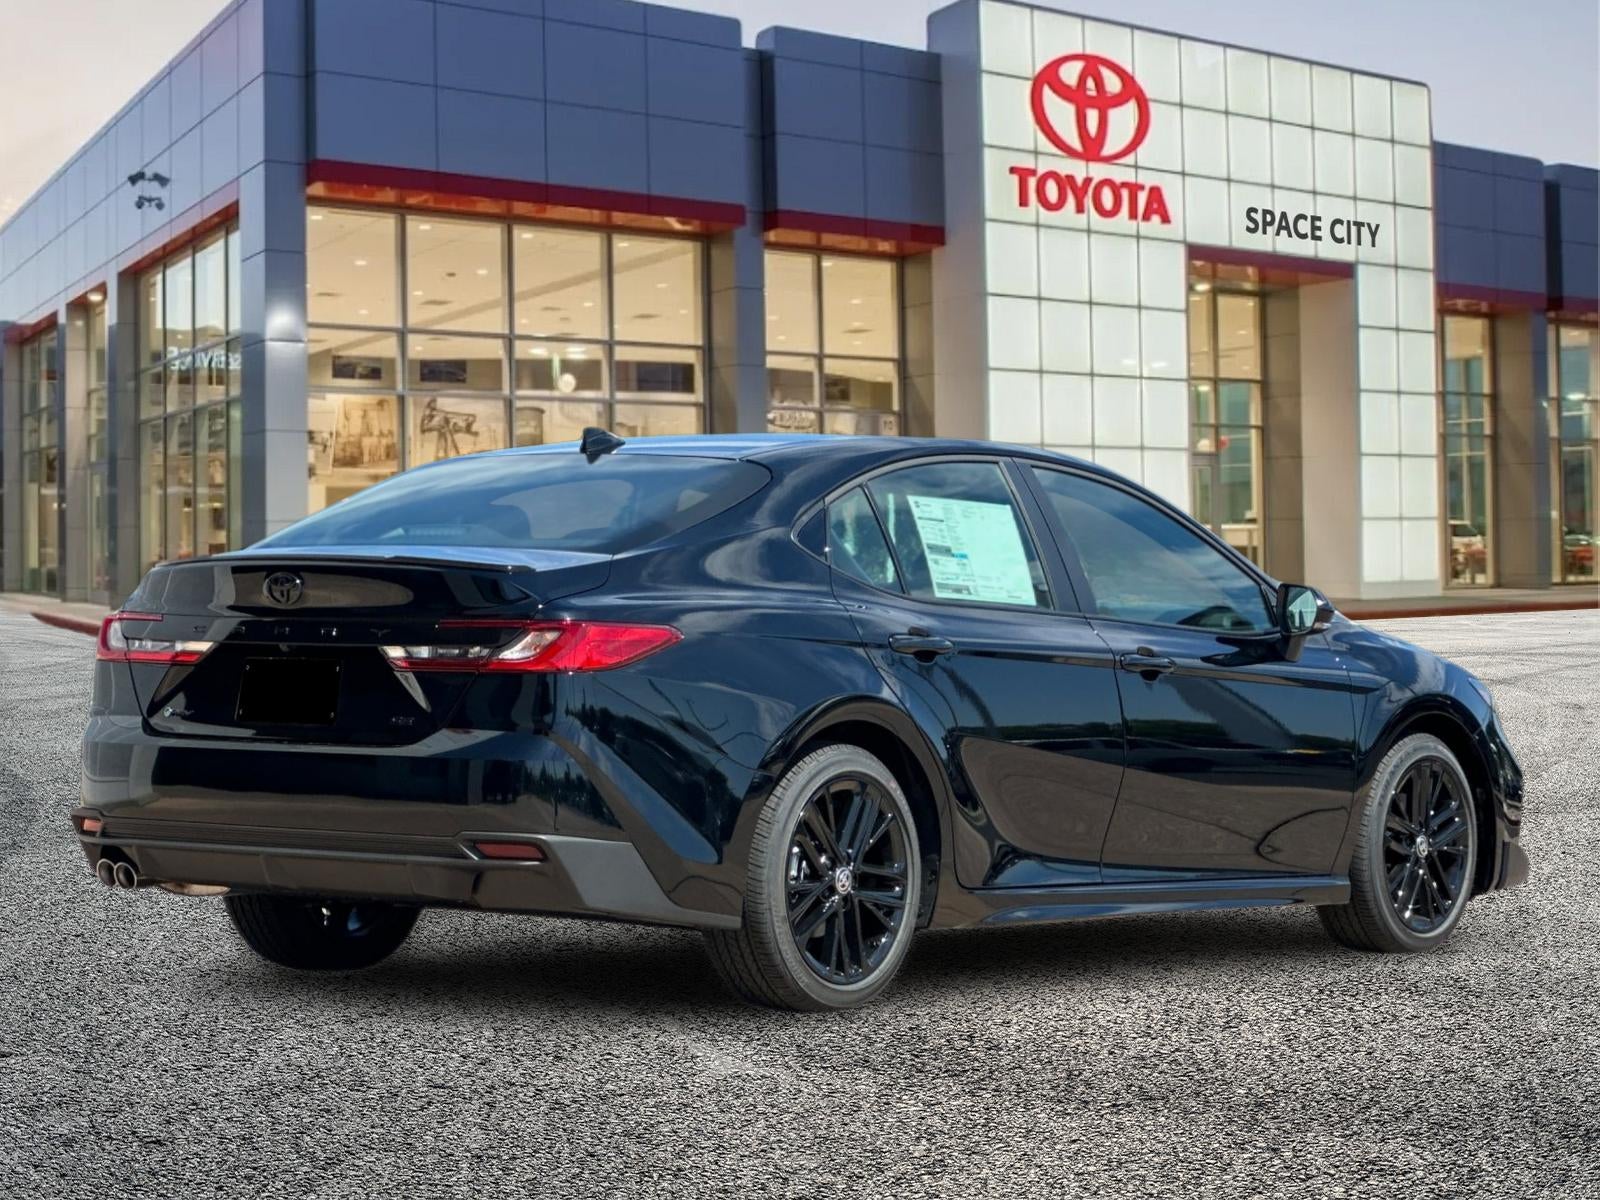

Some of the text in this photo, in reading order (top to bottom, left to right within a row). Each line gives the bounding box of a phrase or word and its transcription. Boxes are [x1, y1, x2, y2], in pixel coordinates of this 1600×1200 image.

[1009, 166, 1171, 224] TOYOTA
[1245, 206, 1381, 248] SPACE CITY
